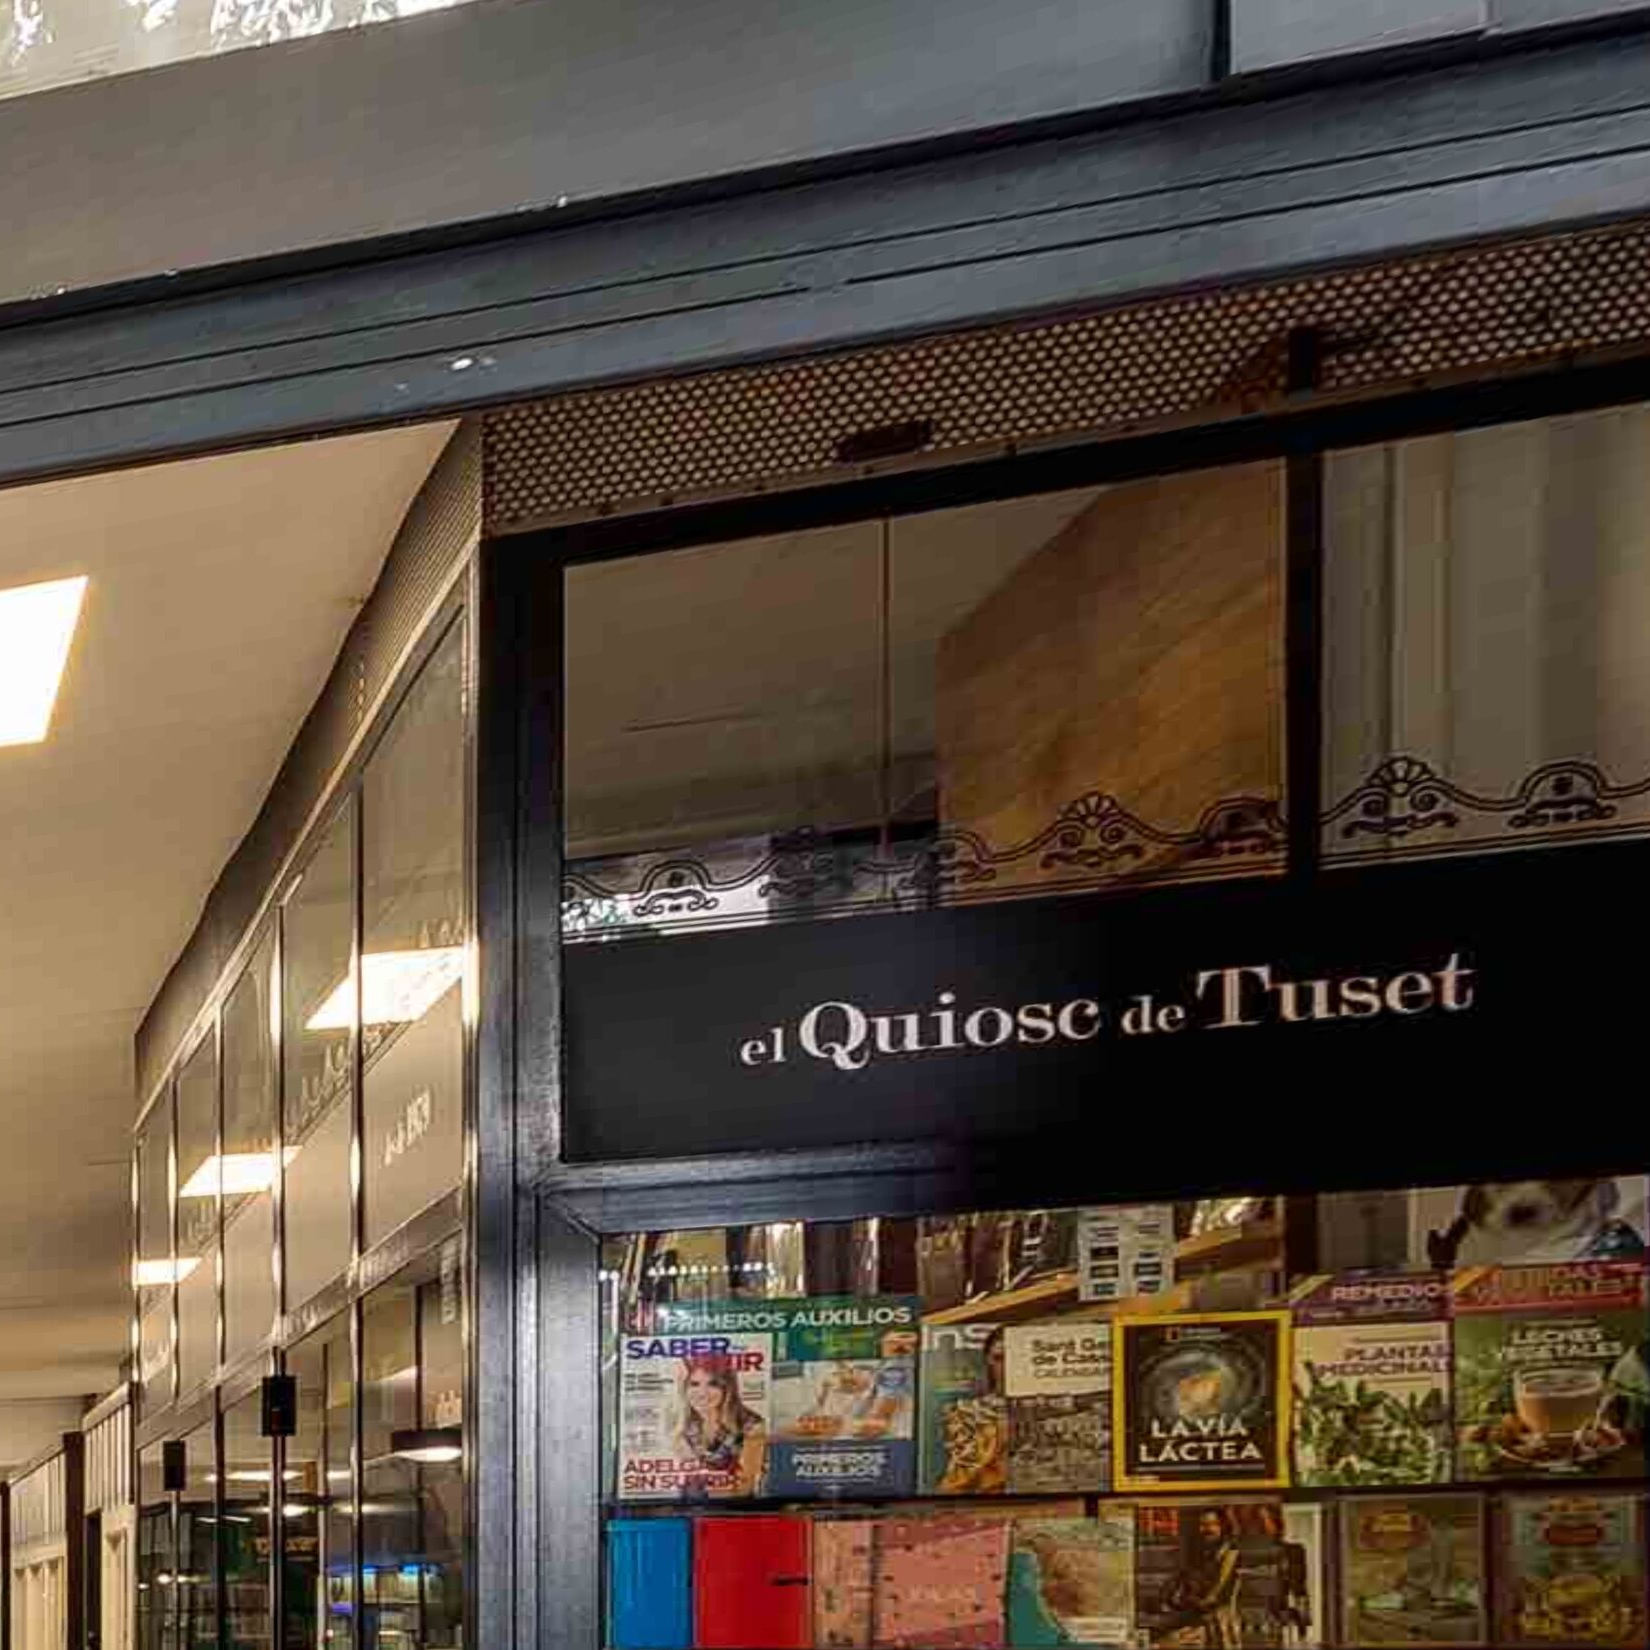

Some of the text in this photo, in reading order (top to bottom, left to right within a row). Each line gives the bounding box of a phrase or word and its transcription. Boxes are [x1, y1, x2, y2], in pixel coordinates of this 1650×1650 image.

[740, 950, 1477, 1070] el Quiosc de Tuset
[663, 1307, 914, 1334] PRIMEROS AUXILIOS
[626, 1337, 731, 1360] SABER
[1151, 1417, 1187, 1438] LA
[1139, 1438, 1263, 1463] LÁCTEA
